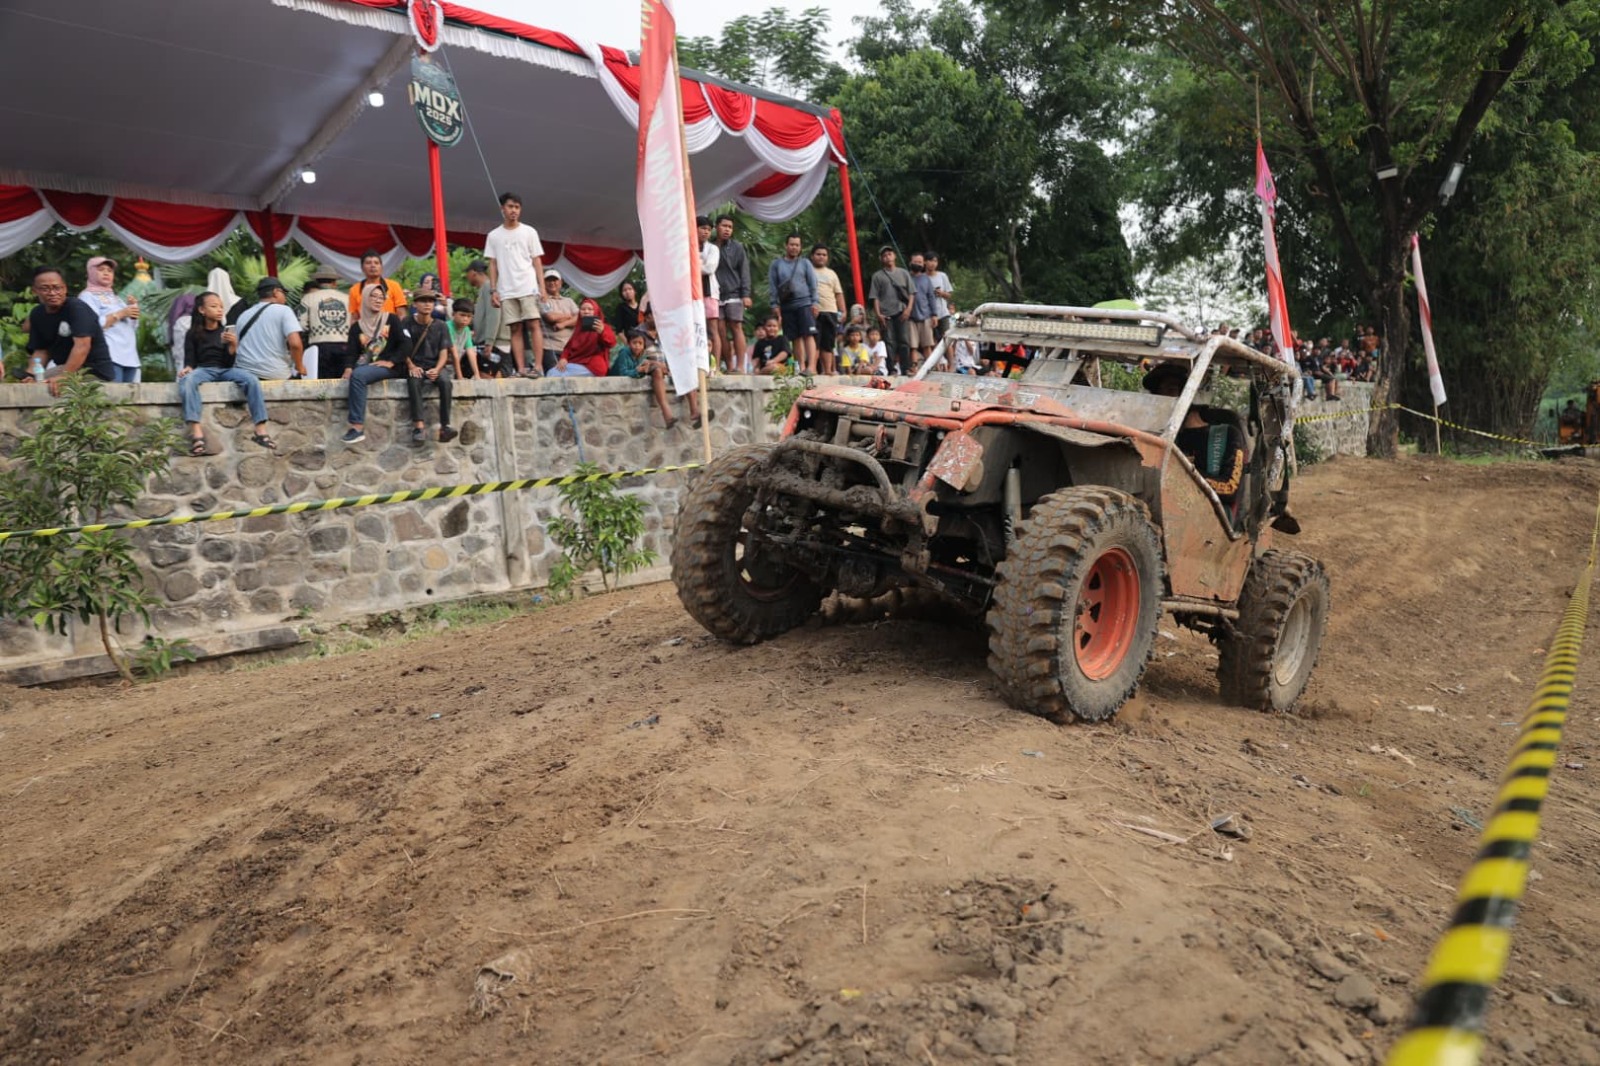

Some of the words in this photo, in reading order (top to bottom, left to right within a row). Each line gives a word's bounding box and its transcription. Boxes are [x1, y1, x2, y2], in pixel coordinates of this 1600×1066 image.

[412, 81, 461, 121] MOX
[426, 106, 452, 126] 2025
[319, 309, 346, 319] MOX
